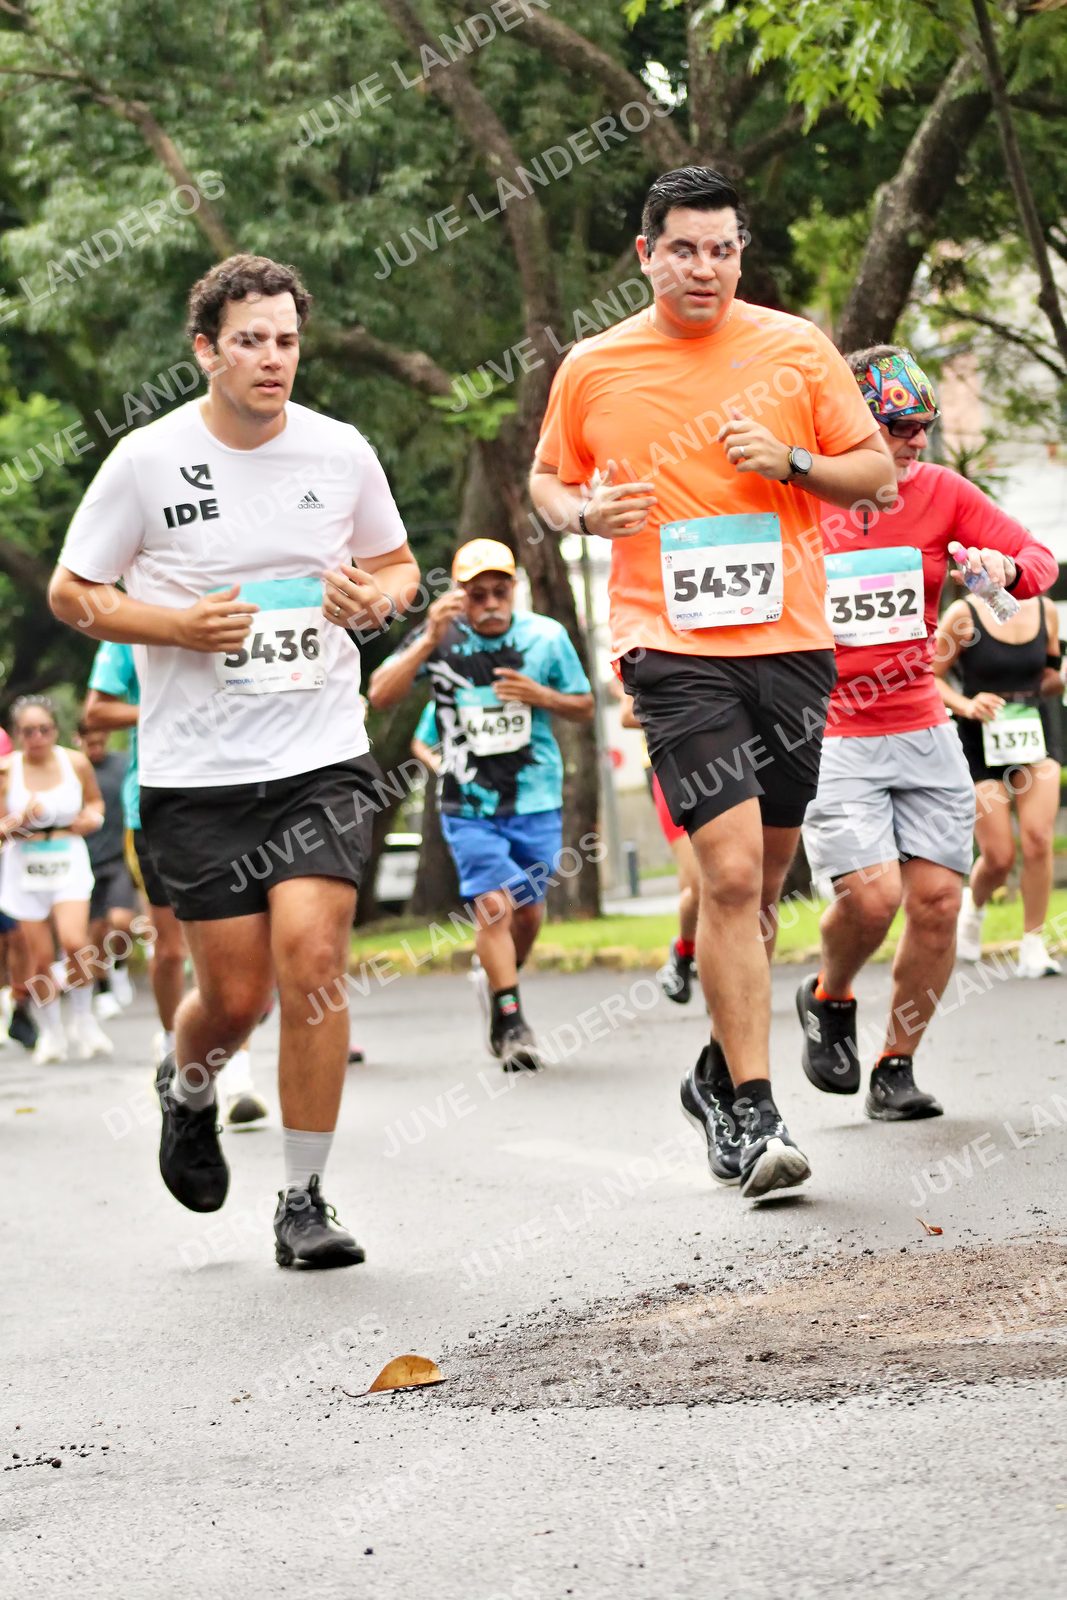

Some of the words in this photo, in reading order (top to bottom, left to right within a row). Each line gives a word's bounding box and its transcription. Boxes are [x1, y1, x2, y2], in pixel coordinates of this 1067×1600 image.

[163, 498, 220, 529] IDE
[673, 562, 774, 602] 5437
[830, 588, 917, 624] 3532
[467, 715, 525, 737] 4499
[990, 730, 1040, 750] 1375
